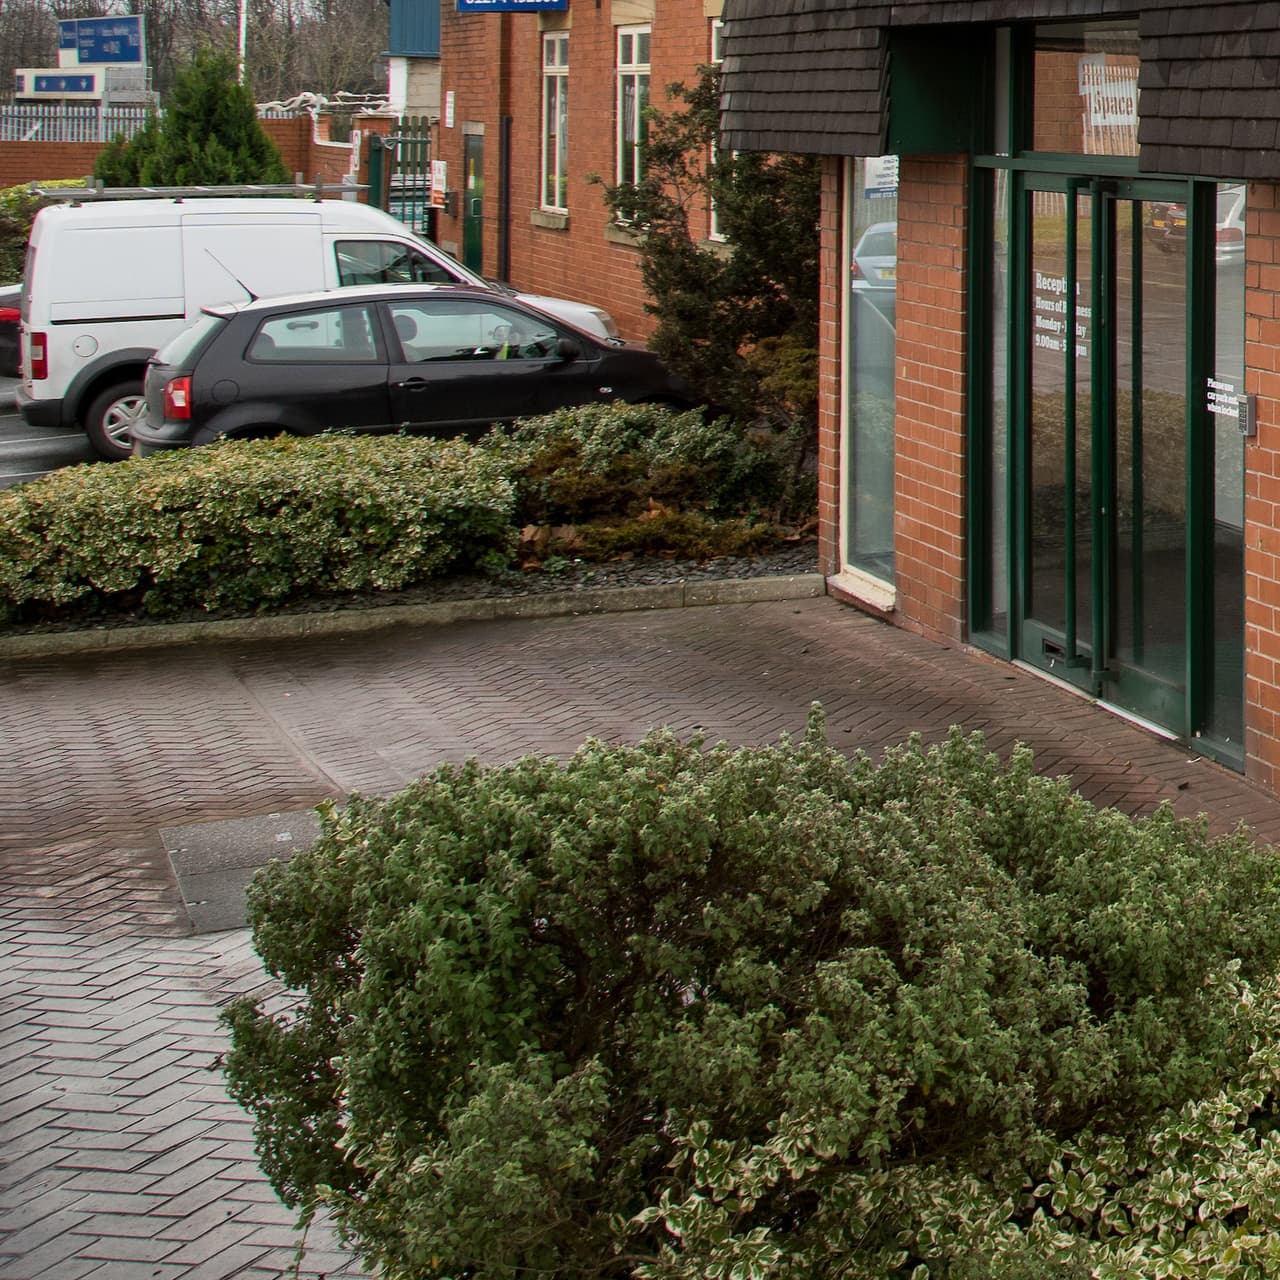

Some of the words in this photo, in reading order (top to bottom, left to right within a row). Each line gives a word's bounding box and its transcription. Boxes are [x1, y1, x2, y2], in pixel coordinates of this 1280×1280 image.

[1094, 90, 1134, 120] Space
[1035, 296, 1055, 312] Hours
[1055, 299, 1063, 312] of
[1035, 315, 1061, 334] Monday
[1035, 334, 1060, 350] 9.00am
